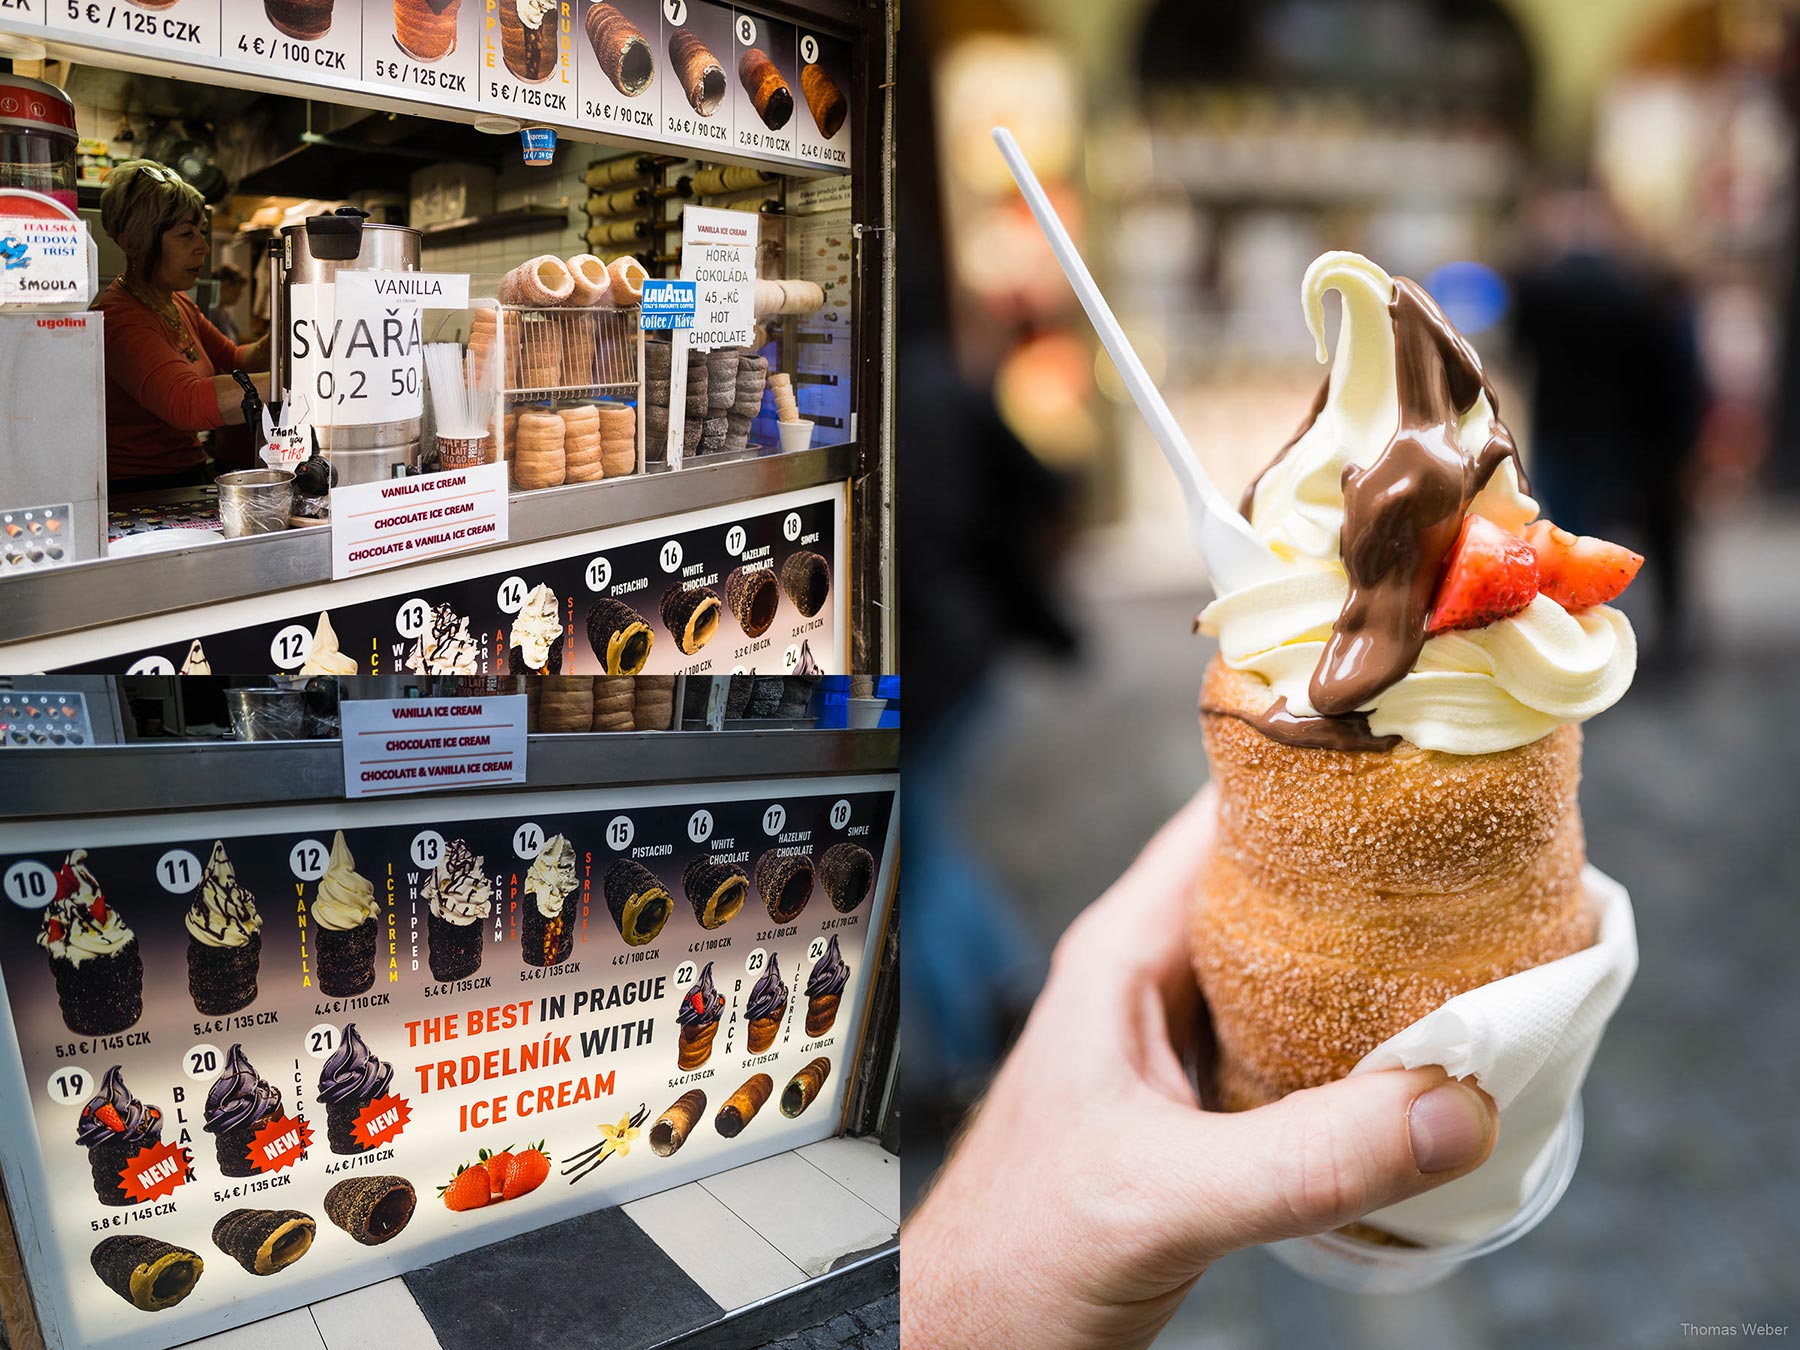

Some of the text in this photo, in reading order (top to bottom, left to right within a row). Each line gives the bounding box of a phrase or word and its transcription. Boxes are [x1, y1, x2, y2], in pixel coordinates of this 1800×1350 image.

[670, 0, 680, 20] 7
[68, 1, 78, 19] 5
[86, 4, 100, 23] €
[123, 11, 156, 35] 125
[164, 20, 200, 43] CZK
[742, 20, 750, 40] 8
[238, 35, 247, 52] 4
[253, 38, 264, 54] €
[283, 43, 309, 63] 100
[315, 50, 345, 70] CZK
[806, 41, 813, 59] 9
[376, 61, 384, 76] 5
[389, 64, 398, 79] €
[413, 68, 435, 86] 125
[440, 73, 466, 92] CZK
[491, 83, 498, 97] 5
[502, 85, 509, 100] €
[522, 89, 541, 106] 125
[544, 93, 566, 110] CZK
[586, 101, 600, 118] 3,6
[604, 105, 611, 118] €
[620, 108, 631, 122] 90
[635, 111, 653, 126] CZK
[802, 144, 812, 157] 2,4
[813, 146, 818, 158] €
[824, 148, 832, 160] 60
[833, 149, 845, 162] CZK
[24, 223, 77, 232] ITALSKÁ
[698, 225, 720, 234] VANILLA
[729, 228, 747, 236] CREAM
[27, 235, 77, 244] LEDOVÁ
[706, 248, 739, 262] HORKÁ
[19, 277, 77, 290] ŠMOULA
[696, 267, 748, 282] ČOKOLÁDA
[375, 279, 442, 295] VANILLA
[644, 284, 694, 302] LAVAZZA
[37, 318, 86, 329] ugolini
[641, 315, 666, 328] Coffee
[675, 313, 694, 327] Káva
[711, 311, 729, 323] HOT
[690, 330, 746, 344] CHOCOLATE
[317, 370, 368, 405] 0,2
[290, 437, 303, 447] you
[281, 447, 304, 461] TIPS
[382, 476, 466, 498] VANILLA ICE CREAM
[374, 503, 474, 530] CHOCOLATE ICE CREAM
[787, 519, 797, 534] 18
[349, 523, 495, 562] CHOCOLATE & VANILLA ICE CREAM
[729, 533, 742, 549] 17
[801, 532, 819, 545] SIMPLE
[664, 547, 677, 566] 16
[590, 564, 606, 584] 15
[683, 563, 703, 577] WHITE
[611, 578, 648, 597] PISTACHIO
[683, 573, 719, 592] CHOCOLATE
[502, 584, 521, 604] 14
[403, 607, 422, 629] 13
[279, 634, 303, 659] 12
[392, 705, 482, 719] VANILLA ICE CREAM
[386, 736, 490, 751] CHOCOLATE ICE CREAM
[361, 761, 512, 781] CHOCOLATE & VANILLA ICE CREAM
[767, 811, 781, 829] 17
[834, 806, 847, 823] 18
[612, 823, 628, 844] 15
[693, 817, 708, 835] 16
[848, 826, 869, 836] SIMPLE
[519, 830, 537, 852] 14
[711, 838, 734, 850] WHITE
[778, 831, 812, 843] HAZELNUT
[417, 838, 437, 860] 13
[632, 844, 672, 858] PISTACHIO
[710, 851, 749, 865] CHOCOLATE
[776, 845, 812, 858] CHOCOLATE
[297, 848, 320, 872] 12
[165, 860, 190, 884] 11
[14, 872, 46, 898] 10
[581, 852, 592, 942] STRUDEL
[510, 874, 518, 941] APPLE
[407, 872, 419, 971] WHIPPED
[296, 883, 311, 987] VANILLA
[388, 913, 398, 983] CREAM
[810, 942, 823, 959] 24
[749, 954, 763, 970] 23
[677, 967, 692, 984] 22
[404, 976, 666, 1047] THE BEST IN PRAGUE
[726, 980, 741, 1054] BLACK
[194, 1020, 212, 1035] 5.4
[214, 1020, 223, 1032] €
[233, 1014, 254, 1029] 135
[257, 1011, 278, 1026] CZK
[56, 1044, 75, 1058] 5.8
[79, 1042, 89, 1054] €
[101, 1036, 124, 1051] 145
[126, 1032, 151, 1046] CZK
[311, 1031, 333, 1052] 21
[191, 1050, 216, 1074] 20
[415, 1018, 654, 1094] TRDELNÍK WITH
[56, 1074, 83, 1097] 19
[460, 1070, 616, 1133] ICE CREAM
[366, 1106, 399, 1137] NEW
[173, 1086, 197, 1184] BLACK
[262, 1130, 301, 1161] NEW
[137, 1156, 178, 1191] NEW
